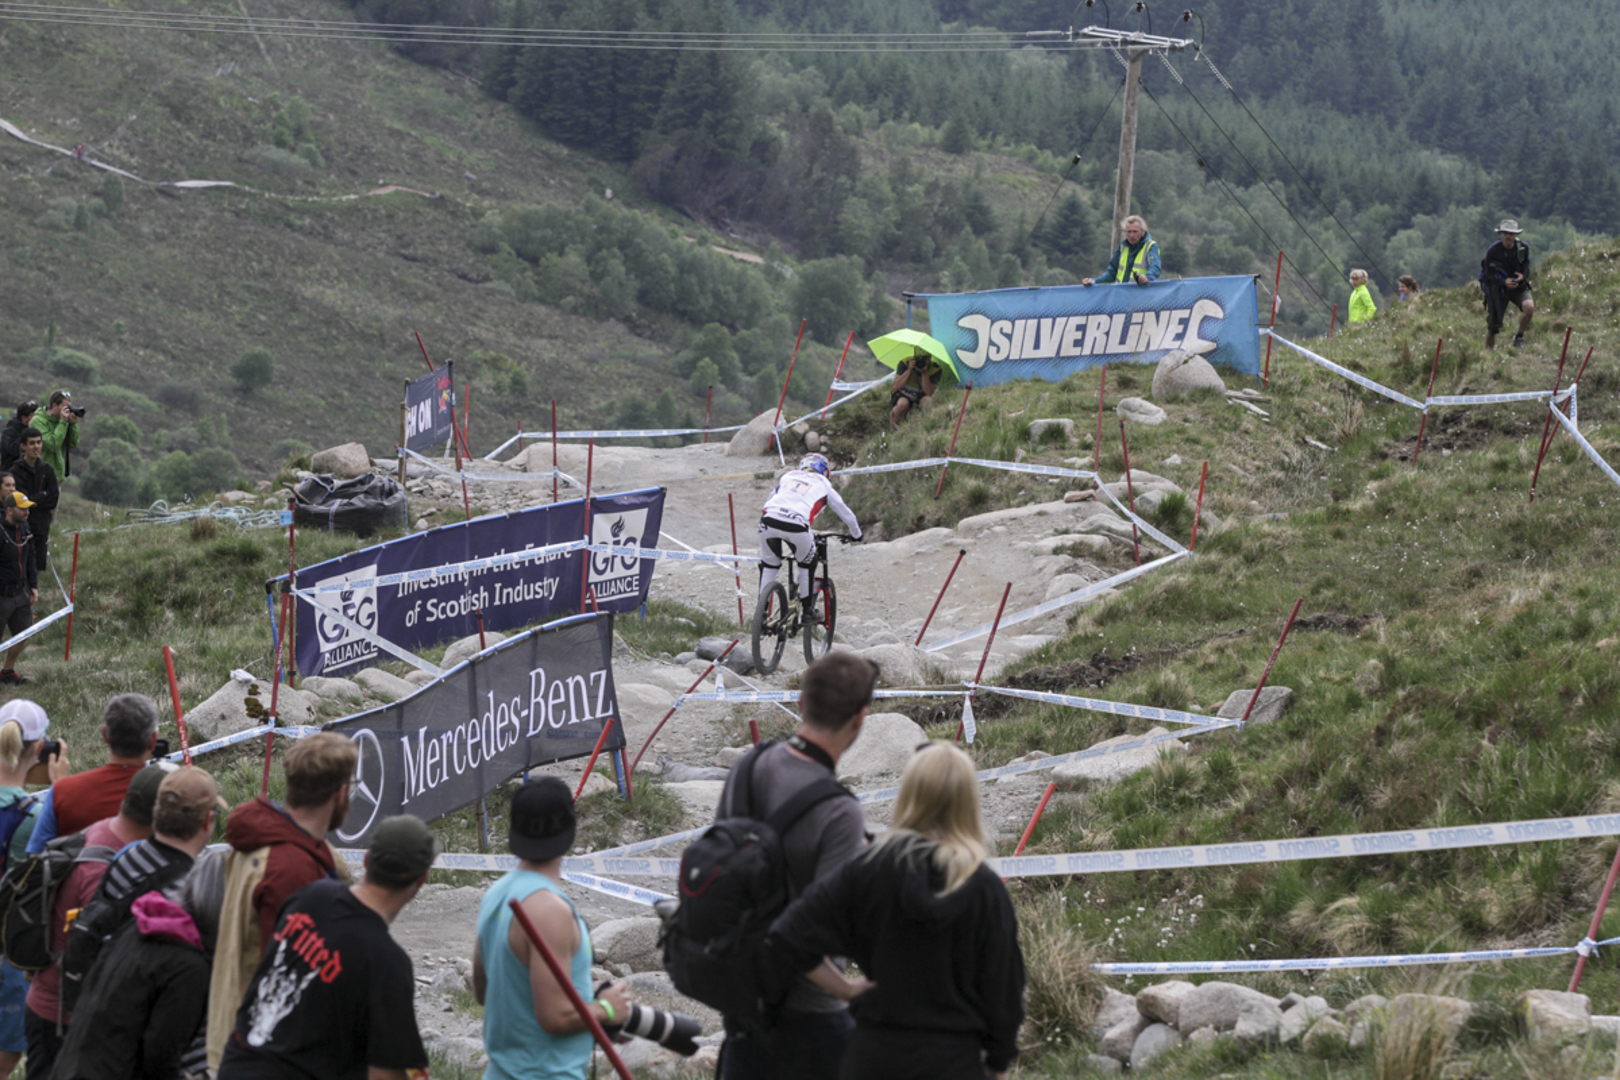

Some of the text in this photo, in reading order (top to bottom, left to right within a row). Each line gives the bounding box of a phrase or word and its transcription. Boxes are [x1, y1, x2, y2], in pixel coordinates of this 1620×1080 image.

[405, 576, 559, 627] of Scottish Industry
[585, 575, 640, 599] ALLIANCE
[179, 725, 189, 763] LISKI
[401, 668, 614, 805] Mercedes-Benz
